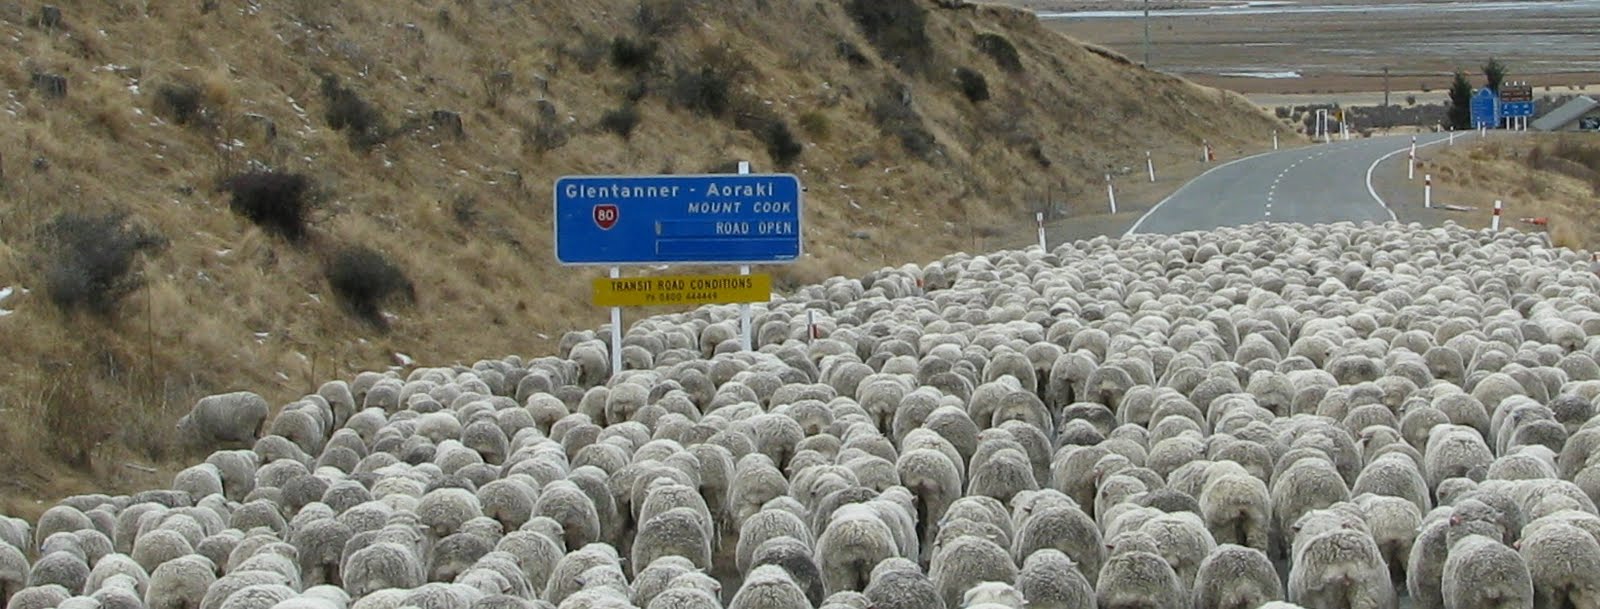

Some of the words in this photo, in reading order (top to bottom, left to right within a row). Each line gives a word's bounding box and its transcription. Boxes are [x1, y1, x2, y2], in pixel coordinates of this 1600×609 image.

[566, 184, 679, 198] Glentanner
[706, 182, 774, 198] Aoraki
[688, 202, 742, 214] MOUNT
[753, 202, 792, 214] COOK
[597, 210, 614, 221] 80
[715, 222, 749, 234] ROAD
[759, 222, 792, 234] OPEN
[611, 281, 652, 292] TRANSIT
[658, 280, 685, 290] ROAD
[690, 278, 752, 290] CONDITIONS
